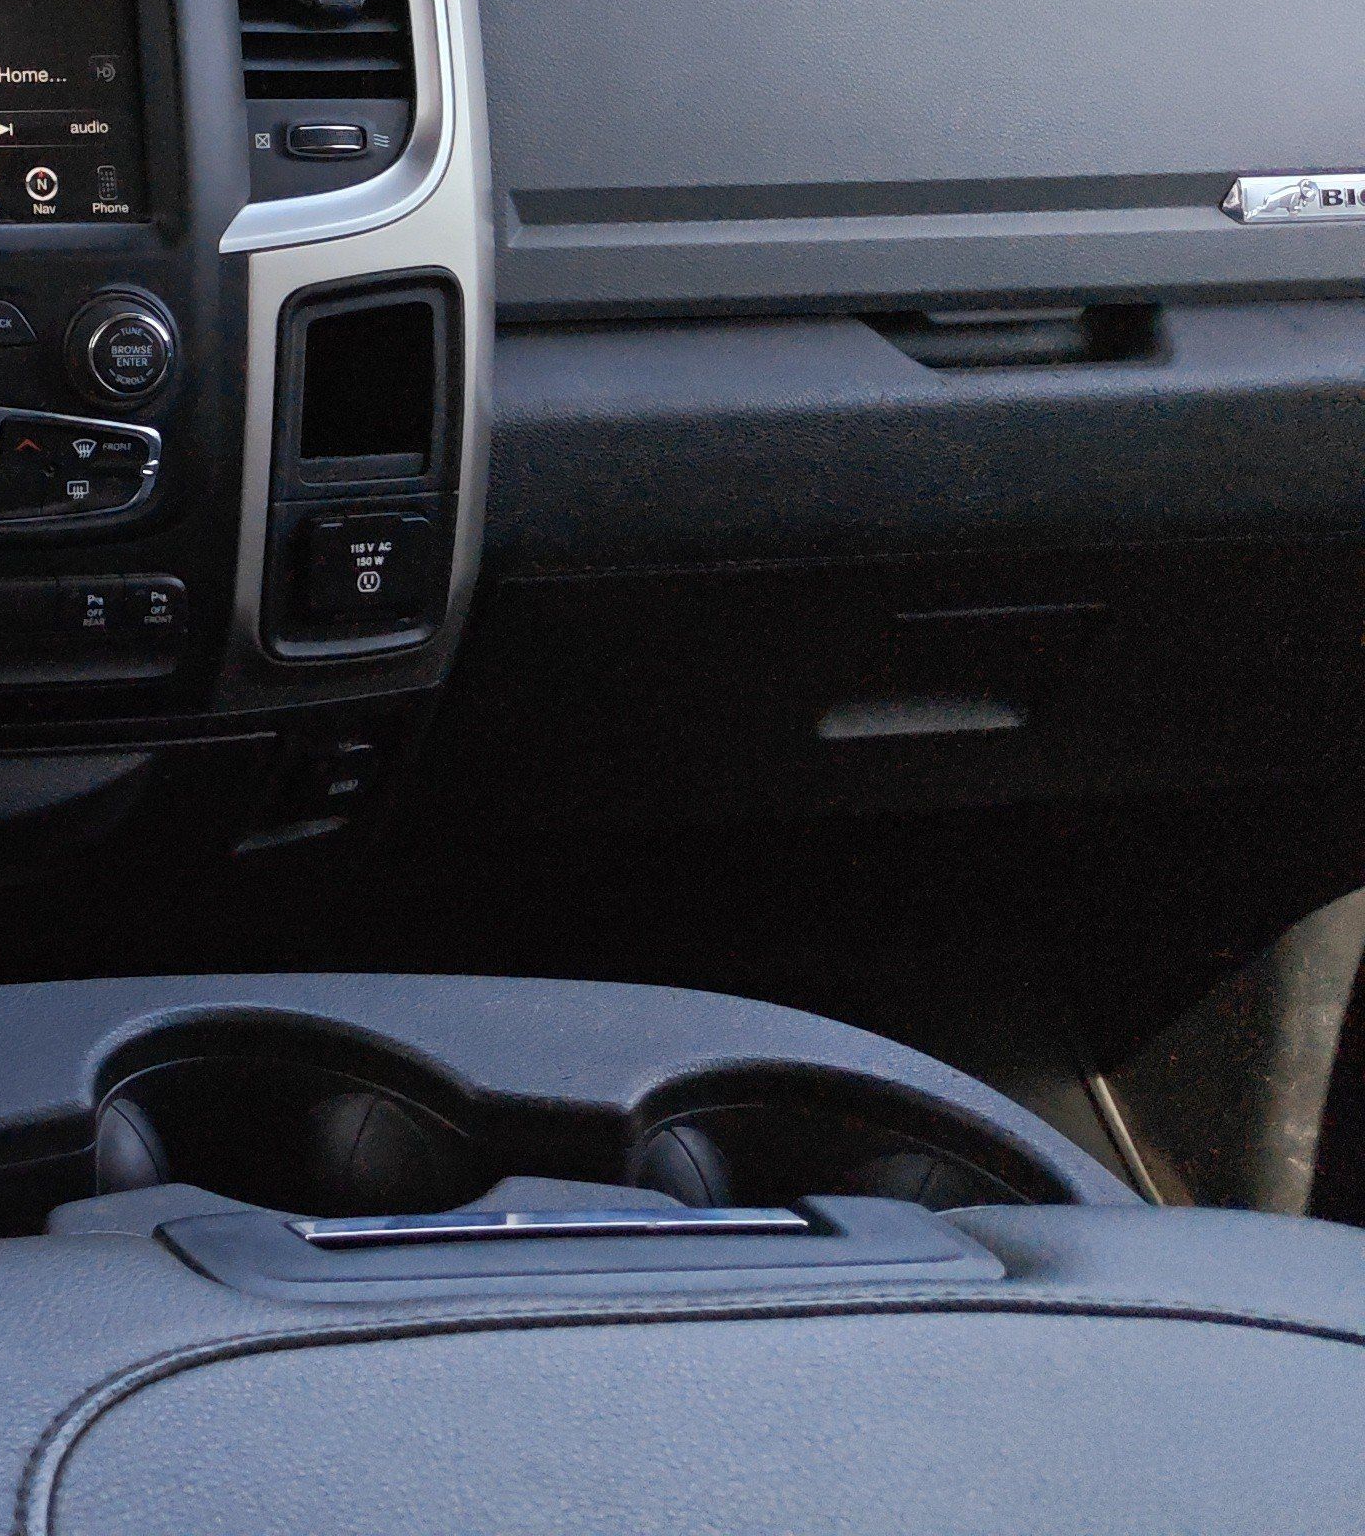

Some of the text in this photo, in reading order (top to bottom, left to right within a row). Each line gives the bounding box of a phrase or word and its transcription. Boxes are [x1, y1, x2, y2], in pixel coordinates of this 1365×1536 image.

[70, 120, 109, 134] audio
[33, 204, 56, 215] Nav
[92, 202, 129, 214] Phone
[110, 344, 153, 355] BROWSE
[116, 357, 148, 367] ENTER
